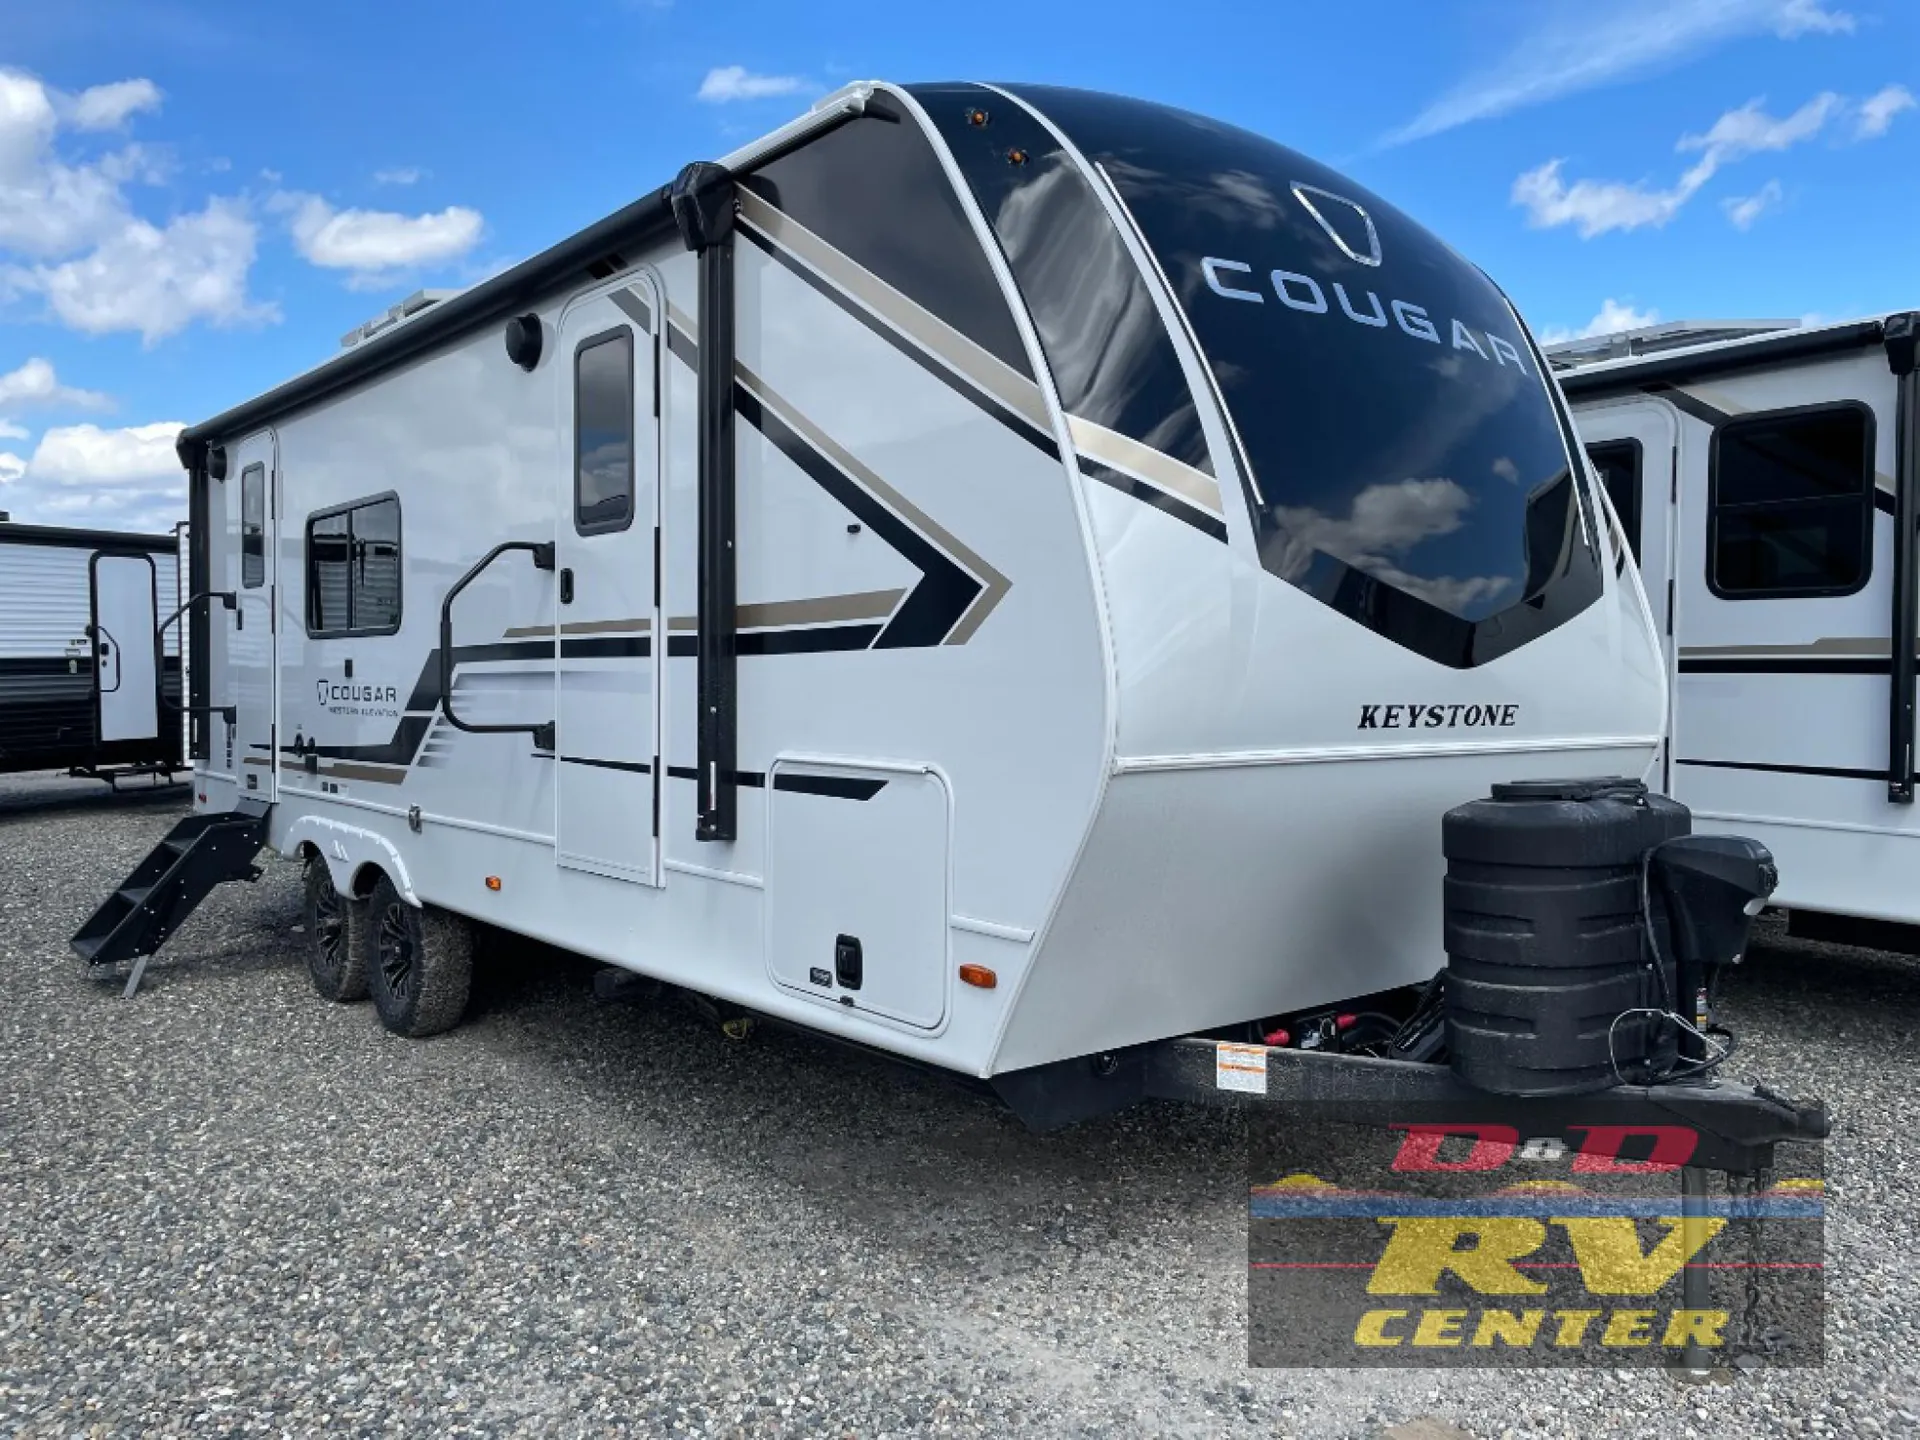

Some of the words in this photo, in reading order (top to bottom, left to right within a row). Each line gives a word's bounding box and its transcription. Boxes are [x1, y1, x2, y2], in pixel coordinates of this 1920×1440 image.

[1201, 256, 1528, 376] COUGAR
[331, 686, 396, 702] COUGAR
[1357, 704, 1520, 730] KEYSTONE
